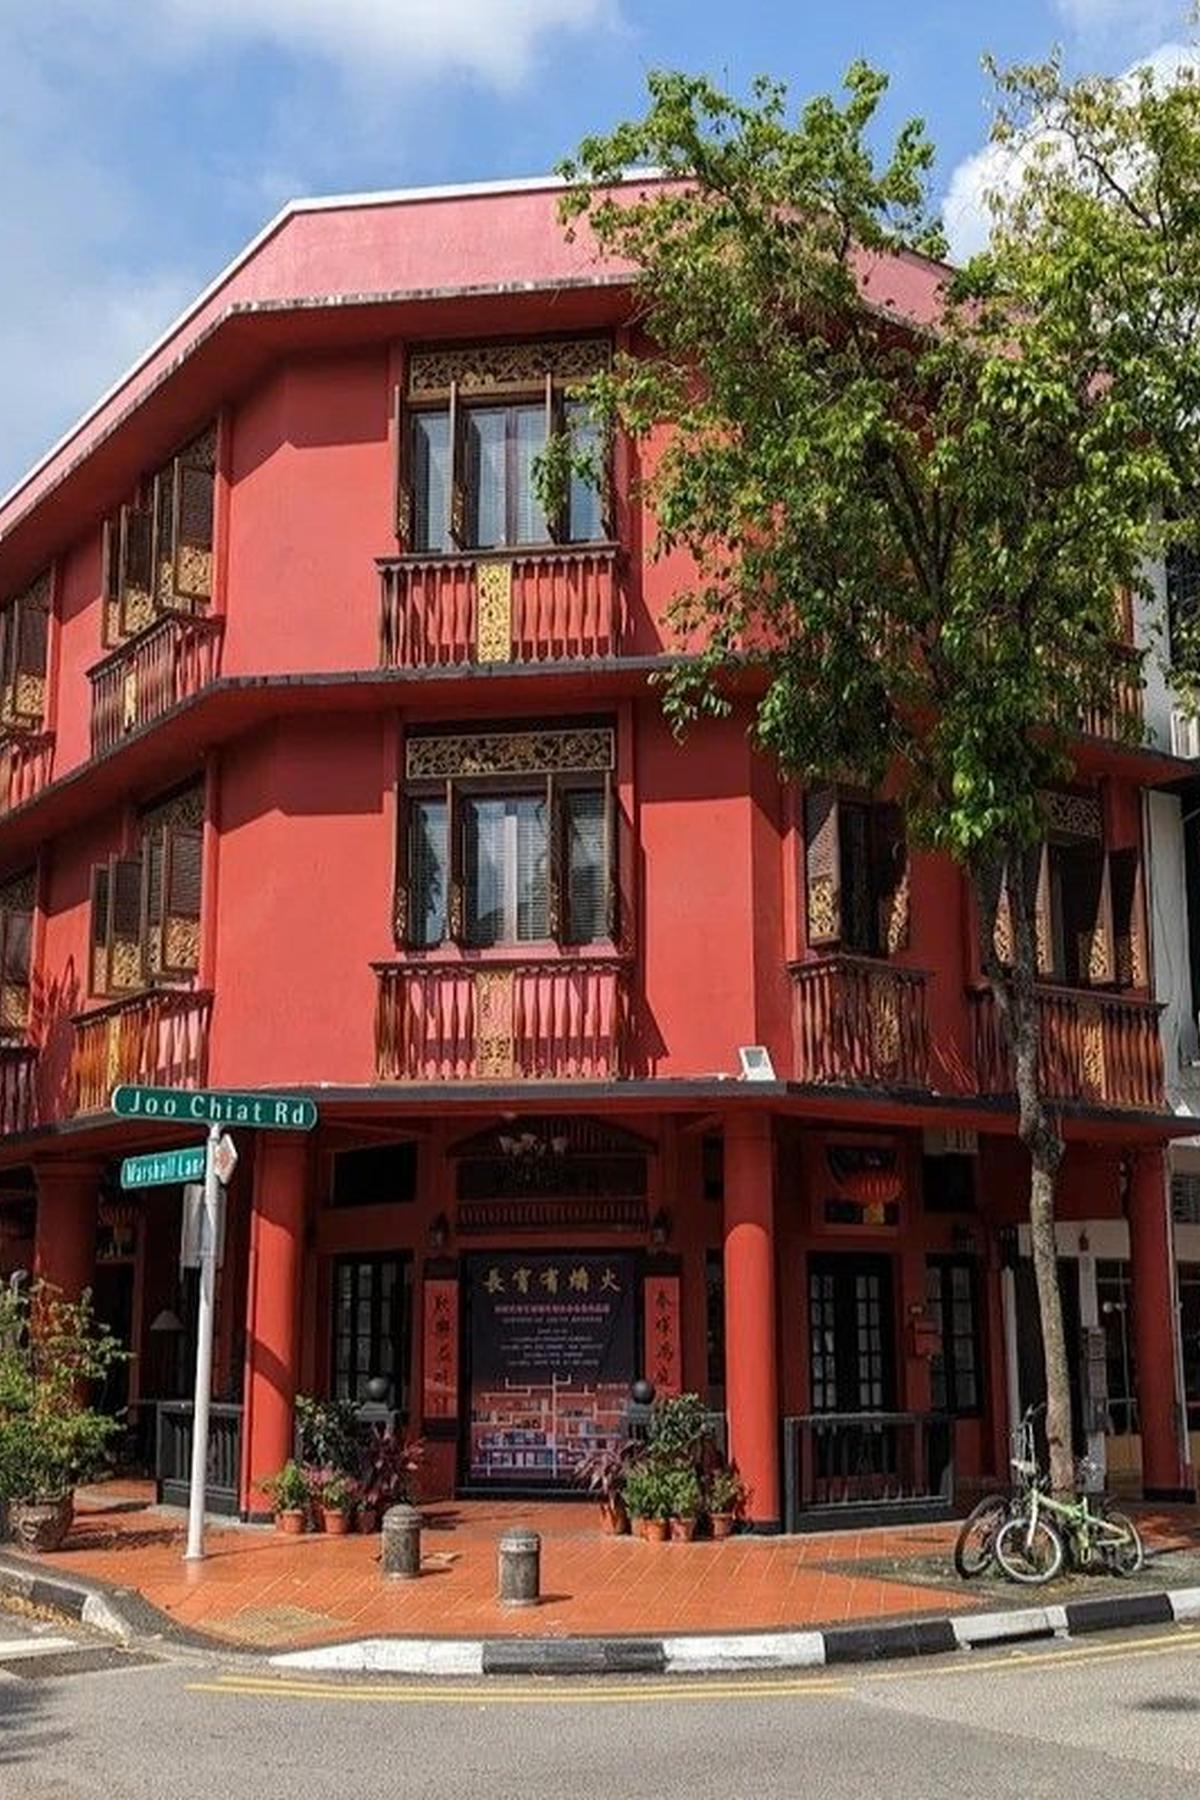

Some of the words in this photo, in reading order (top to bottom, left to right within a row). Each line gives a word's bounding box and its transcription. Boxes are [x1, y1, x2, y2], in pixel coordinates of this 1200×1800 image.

[129, 1090, 176, 1115] Joo
[190, 1095, 262, 1121] Chiat
[275, 1101, 304, 1124] Rd
[126, 1156, 176, 1183] Marshall
